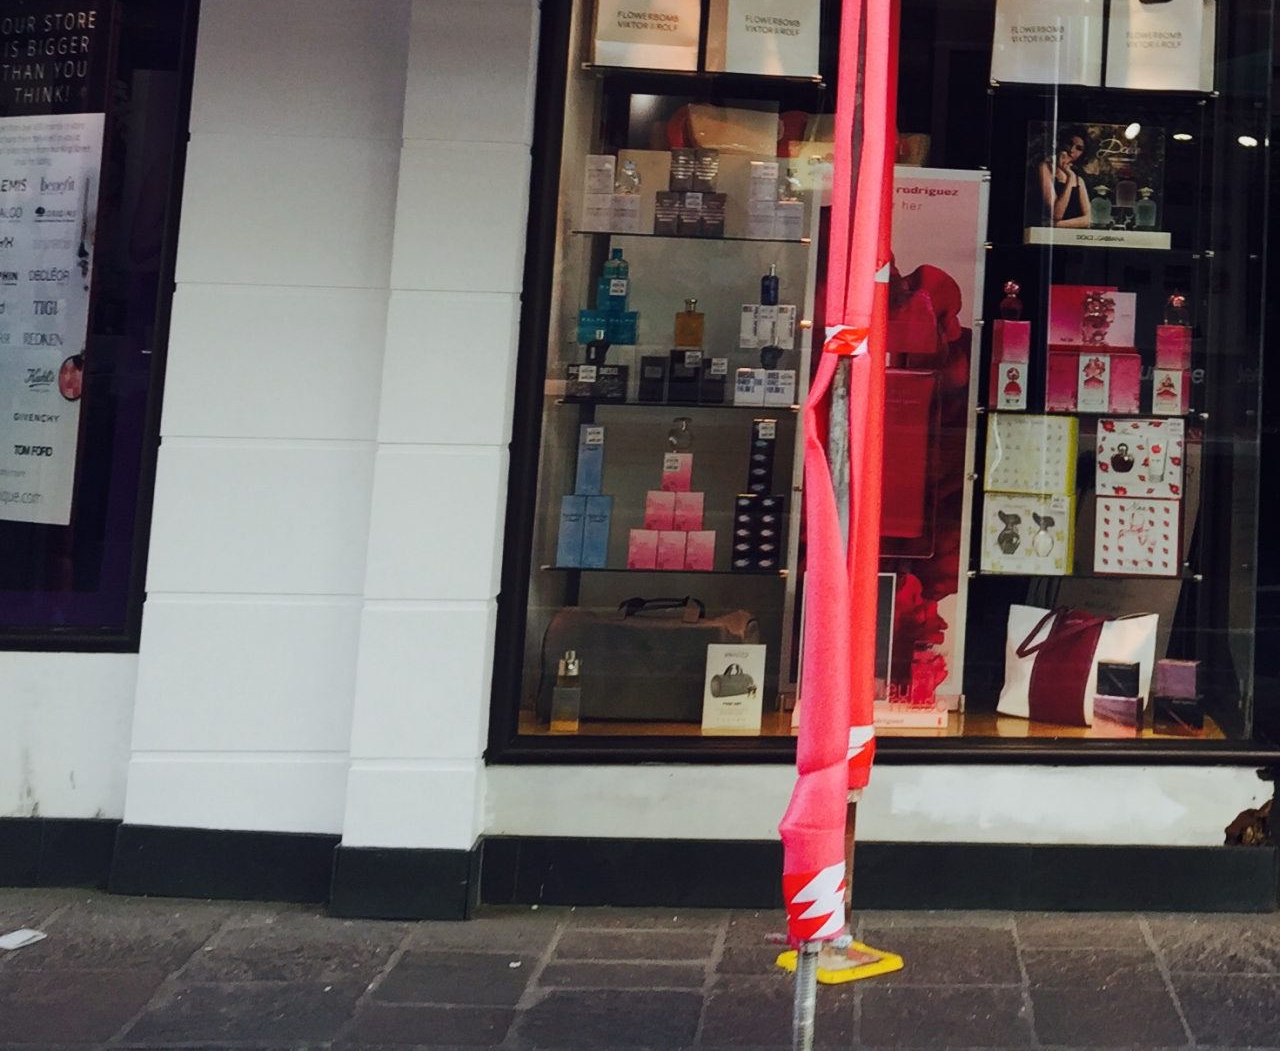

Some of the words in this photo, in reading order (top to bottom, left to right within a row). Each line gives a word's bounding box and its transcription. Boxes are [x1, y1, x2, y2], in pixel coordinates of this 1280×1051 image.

[617, 11, 679, 22] FLOWERBOMB
[1, 16, 36, 35] OUR
[44, 10, 97, 31] STORE
[4, 40, 20, 58] IS
[27, 35, 90, 55] BIGGER
[3, 64, 45, 82] THAN
[54, 60, 88, 79] YOU
[896, 186, 959, 197] rodriguez
[902, 200, 923, 211] her
[13, 412, 60, 423] GIVENCHY
